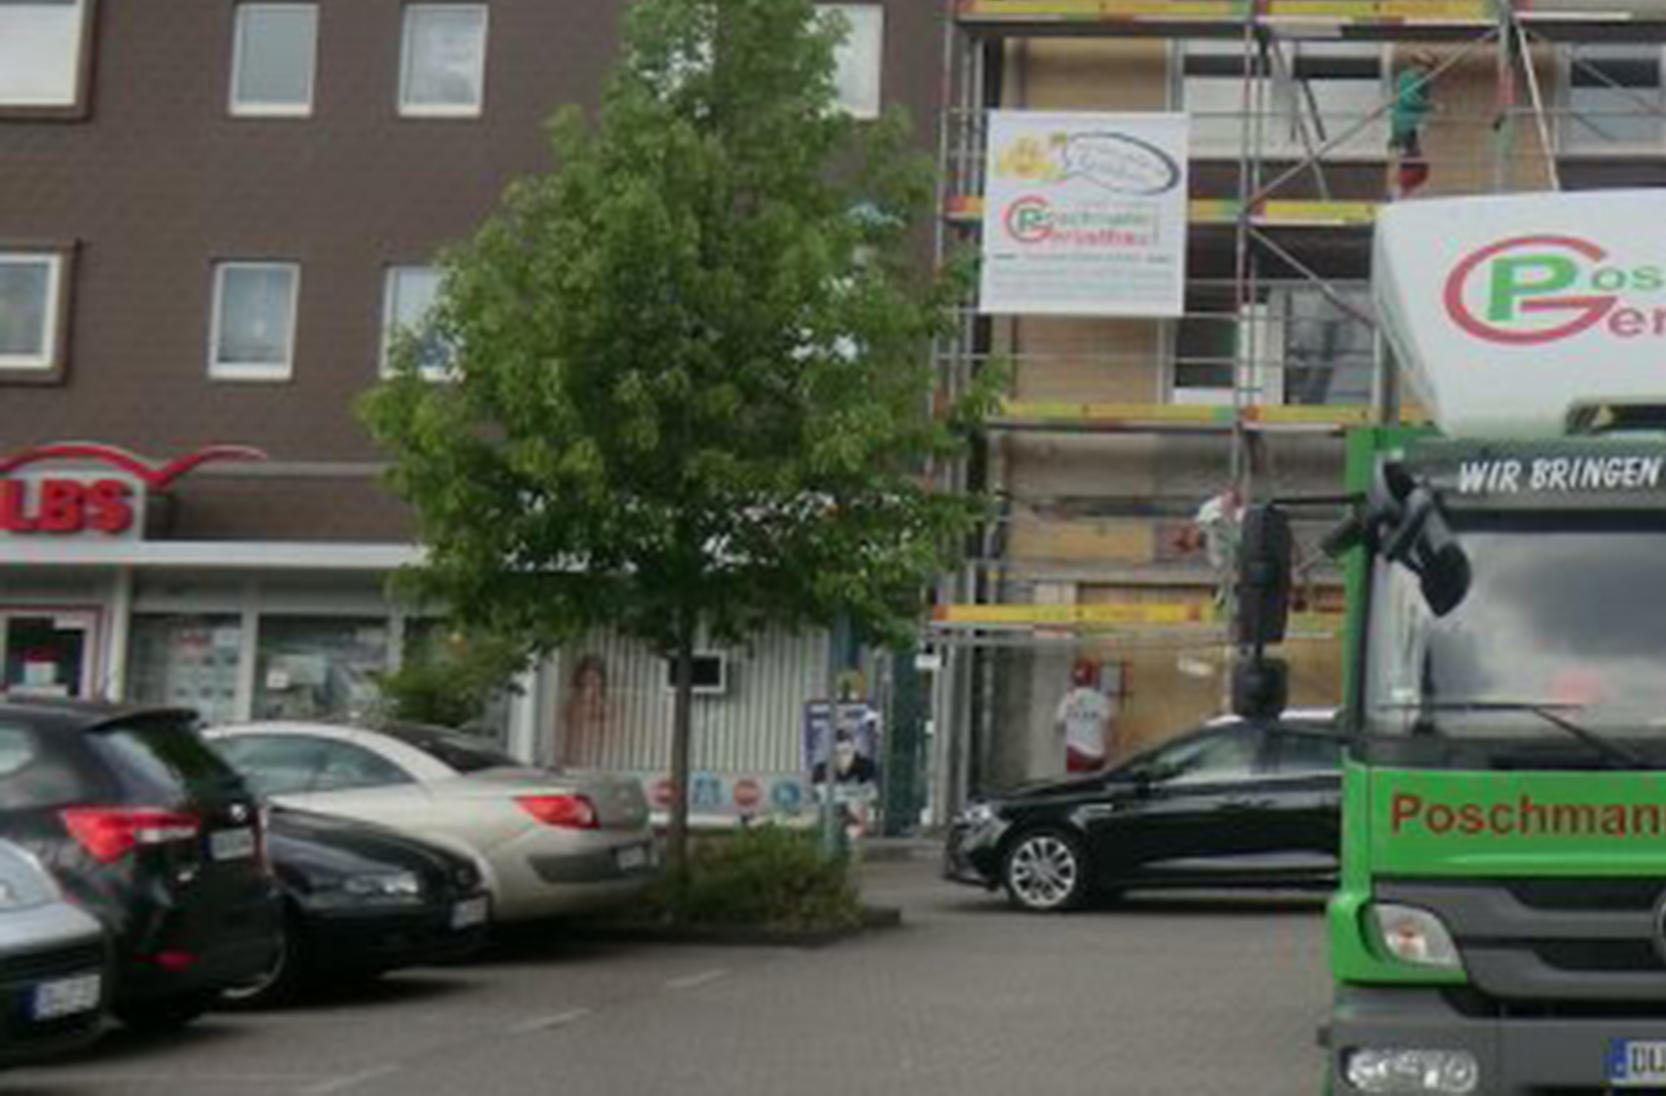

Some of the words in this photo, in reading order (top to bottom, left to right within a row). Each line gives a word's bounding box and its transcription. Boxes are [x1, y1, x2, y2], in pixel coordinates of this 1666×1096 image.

[1459, 459, 1519, 494] WIR
[1530, 455, 1660, 490] BRINGEN
[0, 478, 133, 531] LBS
